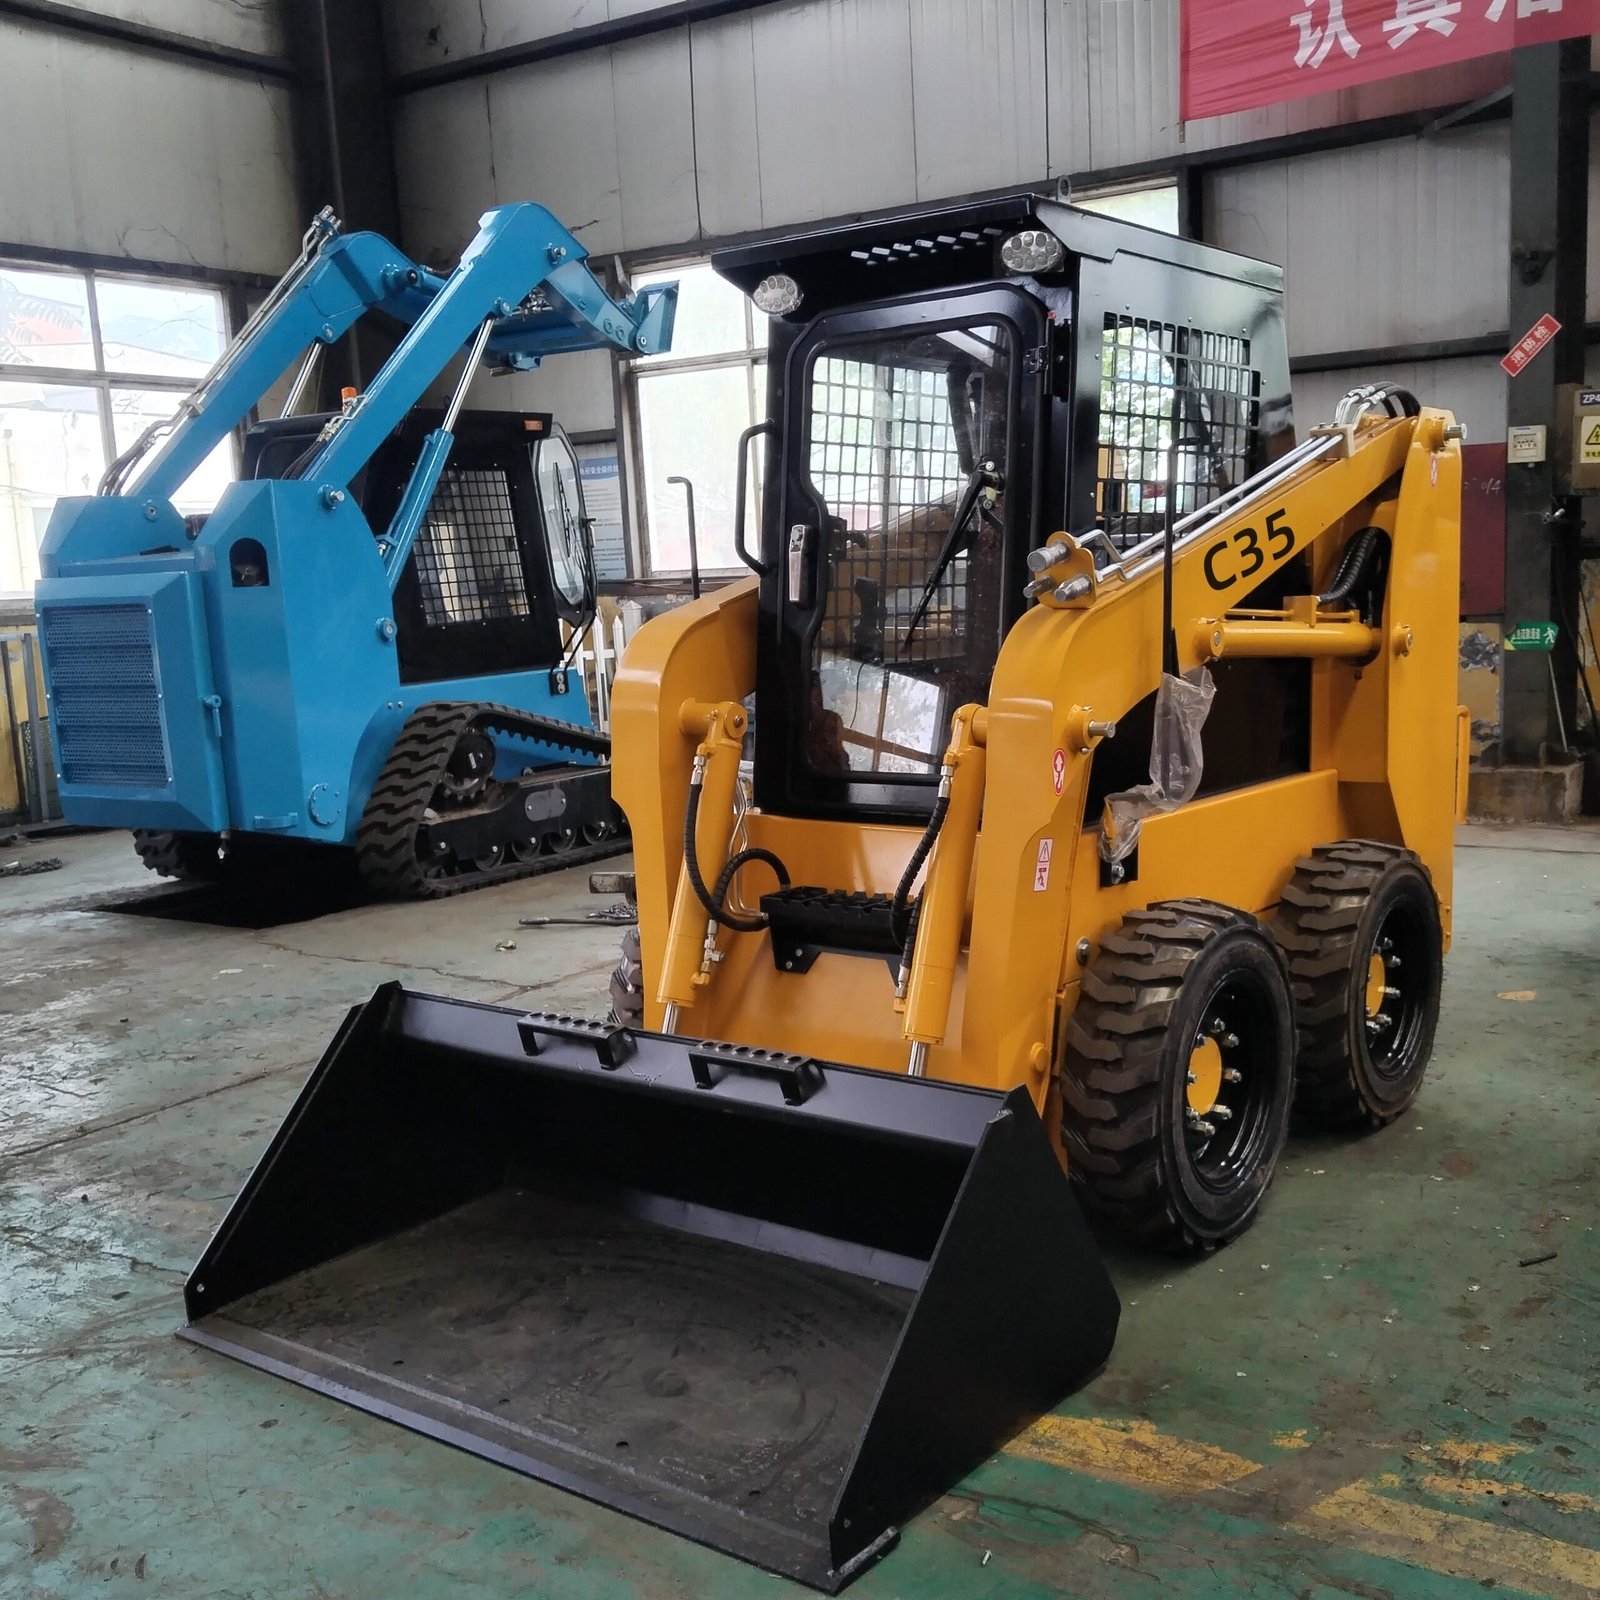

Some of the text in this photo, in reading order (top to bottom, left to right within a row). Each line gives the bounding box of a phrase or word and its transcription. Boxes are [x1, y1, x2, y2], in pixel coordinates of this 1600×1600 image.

[1511, 325, 1548, 364] 消防栓
[1204, 508, 1295, 590] C35
